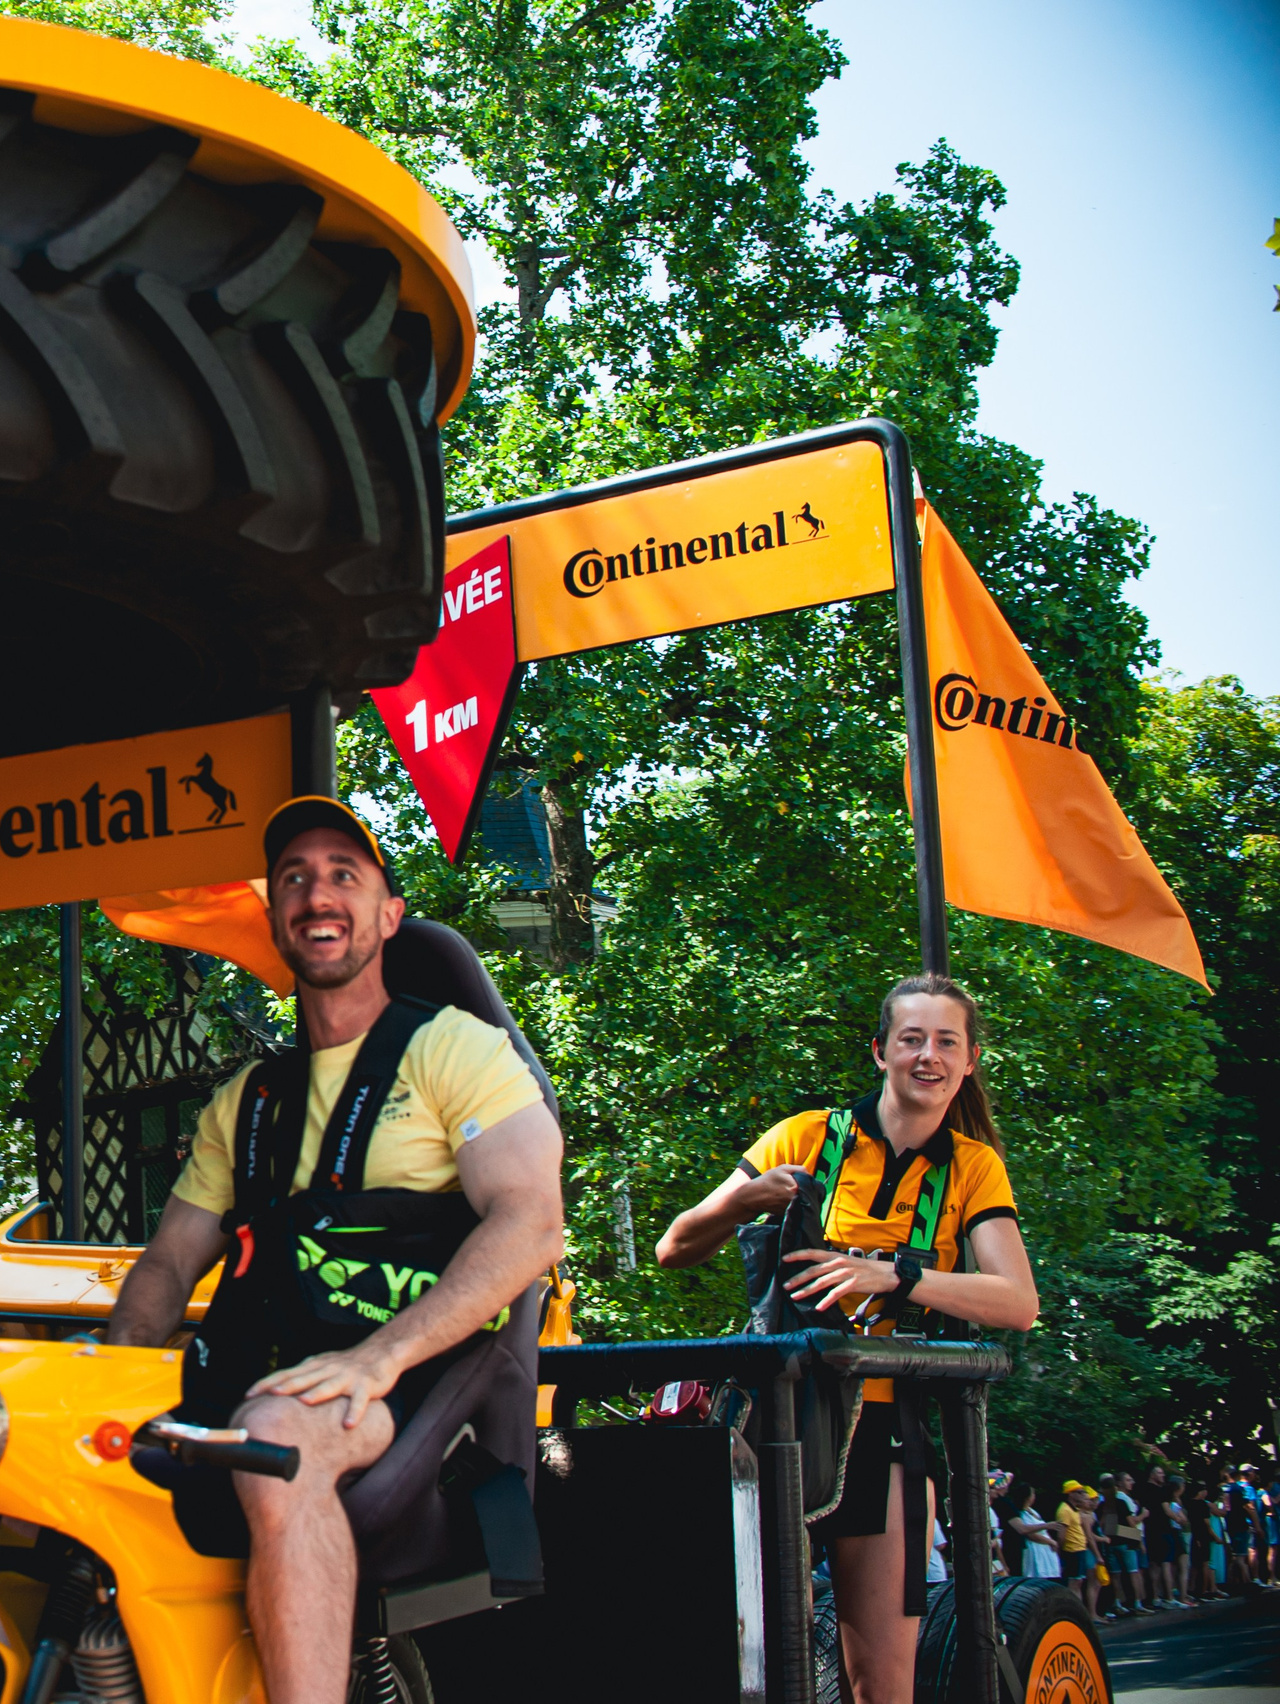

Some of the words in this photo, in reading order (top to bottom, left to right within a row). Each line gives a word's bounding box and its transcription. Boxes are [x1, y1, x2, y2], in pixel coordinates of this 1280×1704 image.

[563, 511, 789, 598] Continental
[405, 699, 428, 753] 1
[434, 696, 478, 743] KM
[935, 673, 1091, 756] Contin
